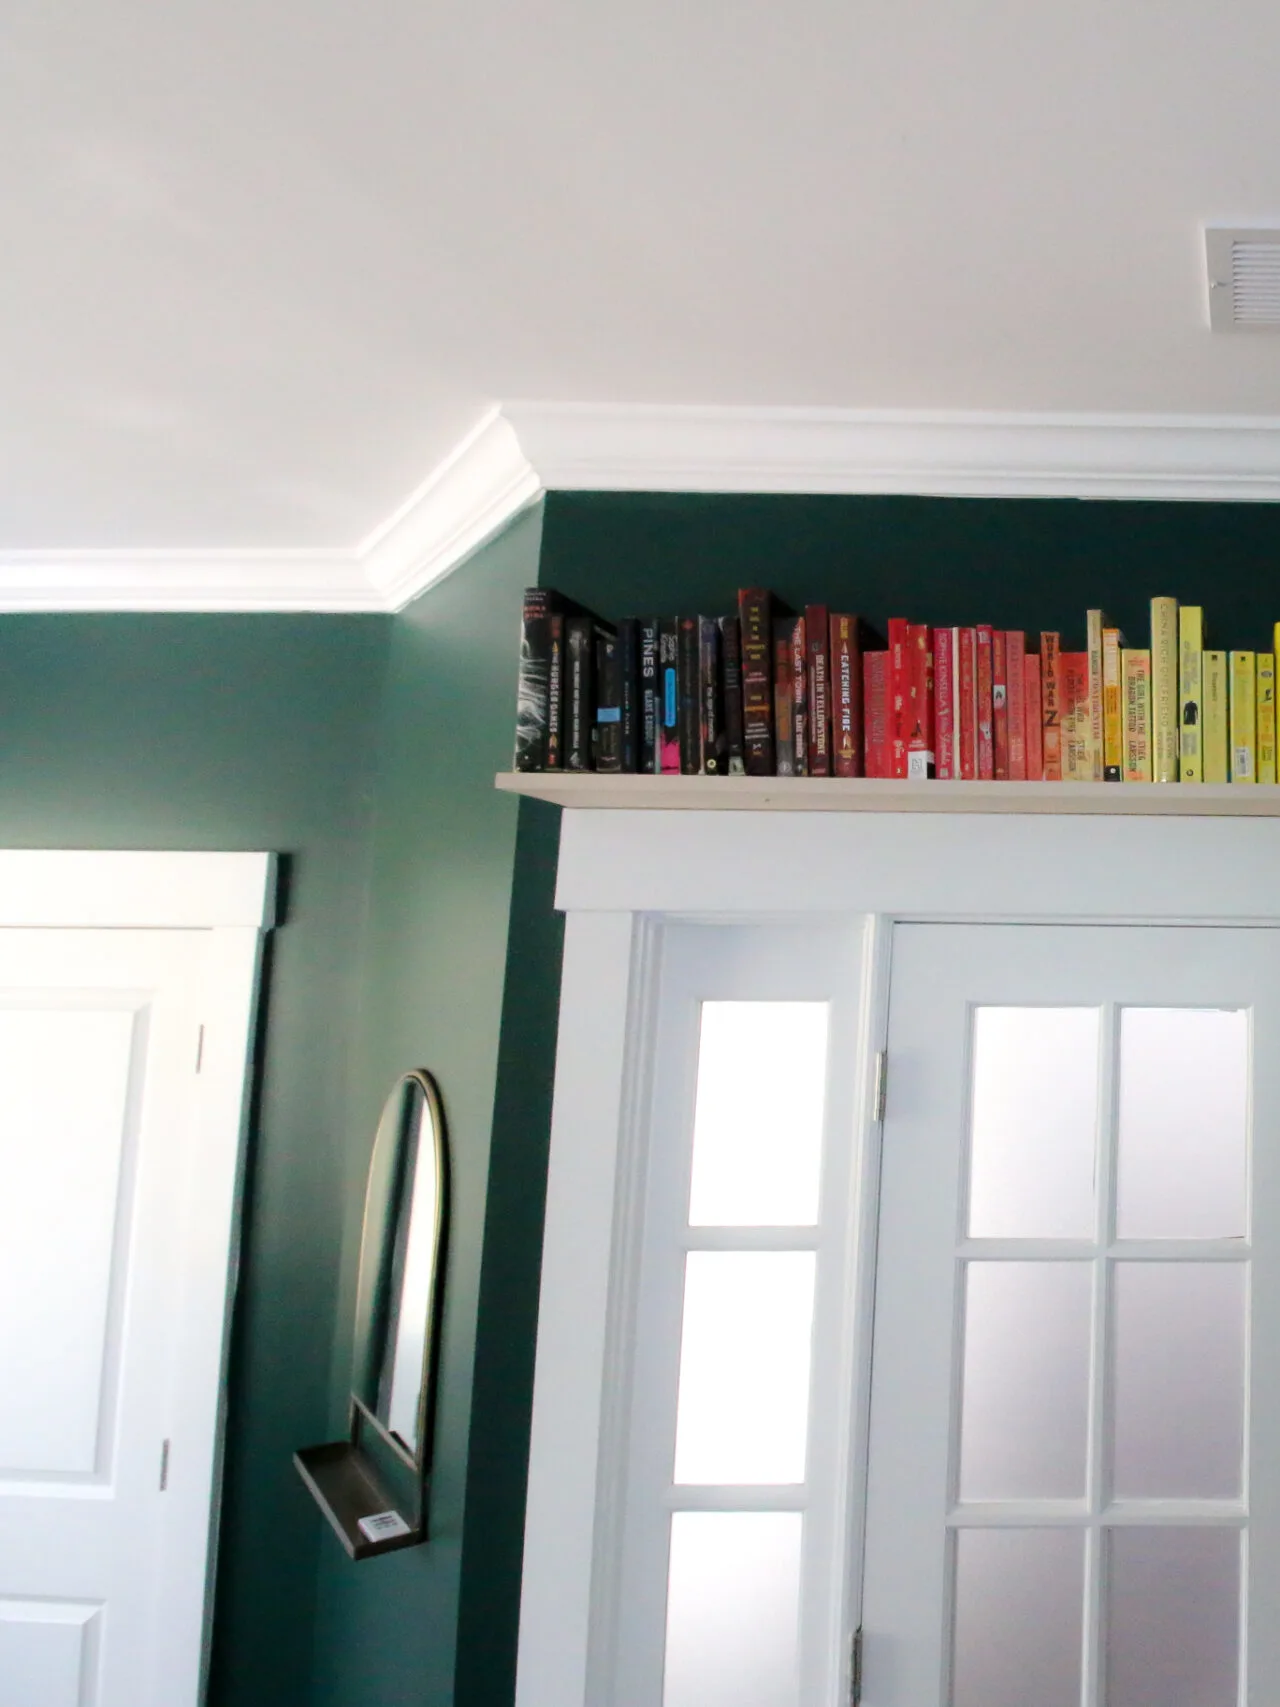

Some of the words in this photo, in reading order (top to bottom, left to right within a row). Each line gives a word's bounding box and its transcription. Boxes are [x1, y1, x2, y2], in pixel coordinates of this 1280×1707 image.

[794, 626, 802, 645] THE
[643, 628, 654, 678] PINES
[794, 646, 802, 672] LAST
[1045, 635, 1055, 678] WORLD
[815, 654, 825, 682] DEATH
[840, 654, 850, 704] CATCHING
[1137, 669, 1145, 682] THE
[794, 676, 802, 704] TOWN
[816, 683, 825, 691] IN
[939, 665, 948, 708] KINSELLA
[1046, 682, 1056, 707] WAR
[1127, 676, 1136, 705] DRAGON
[1137, 684, 1145, 701] GIRL
[549, 704, 560, 733] GAMES
[816, 693, 826, 755] YELLOWSTONE
[1044, 710, 1060, 727] Z
[1127, 707, 1136, 733] TATTOO
[1137, 703, 1145, 720] WITH
[1137, 722, 1145, 736] THE
[1128, 740, 1137, 772] LARSSON
[1137, 740, 1145, 760] STIEG
